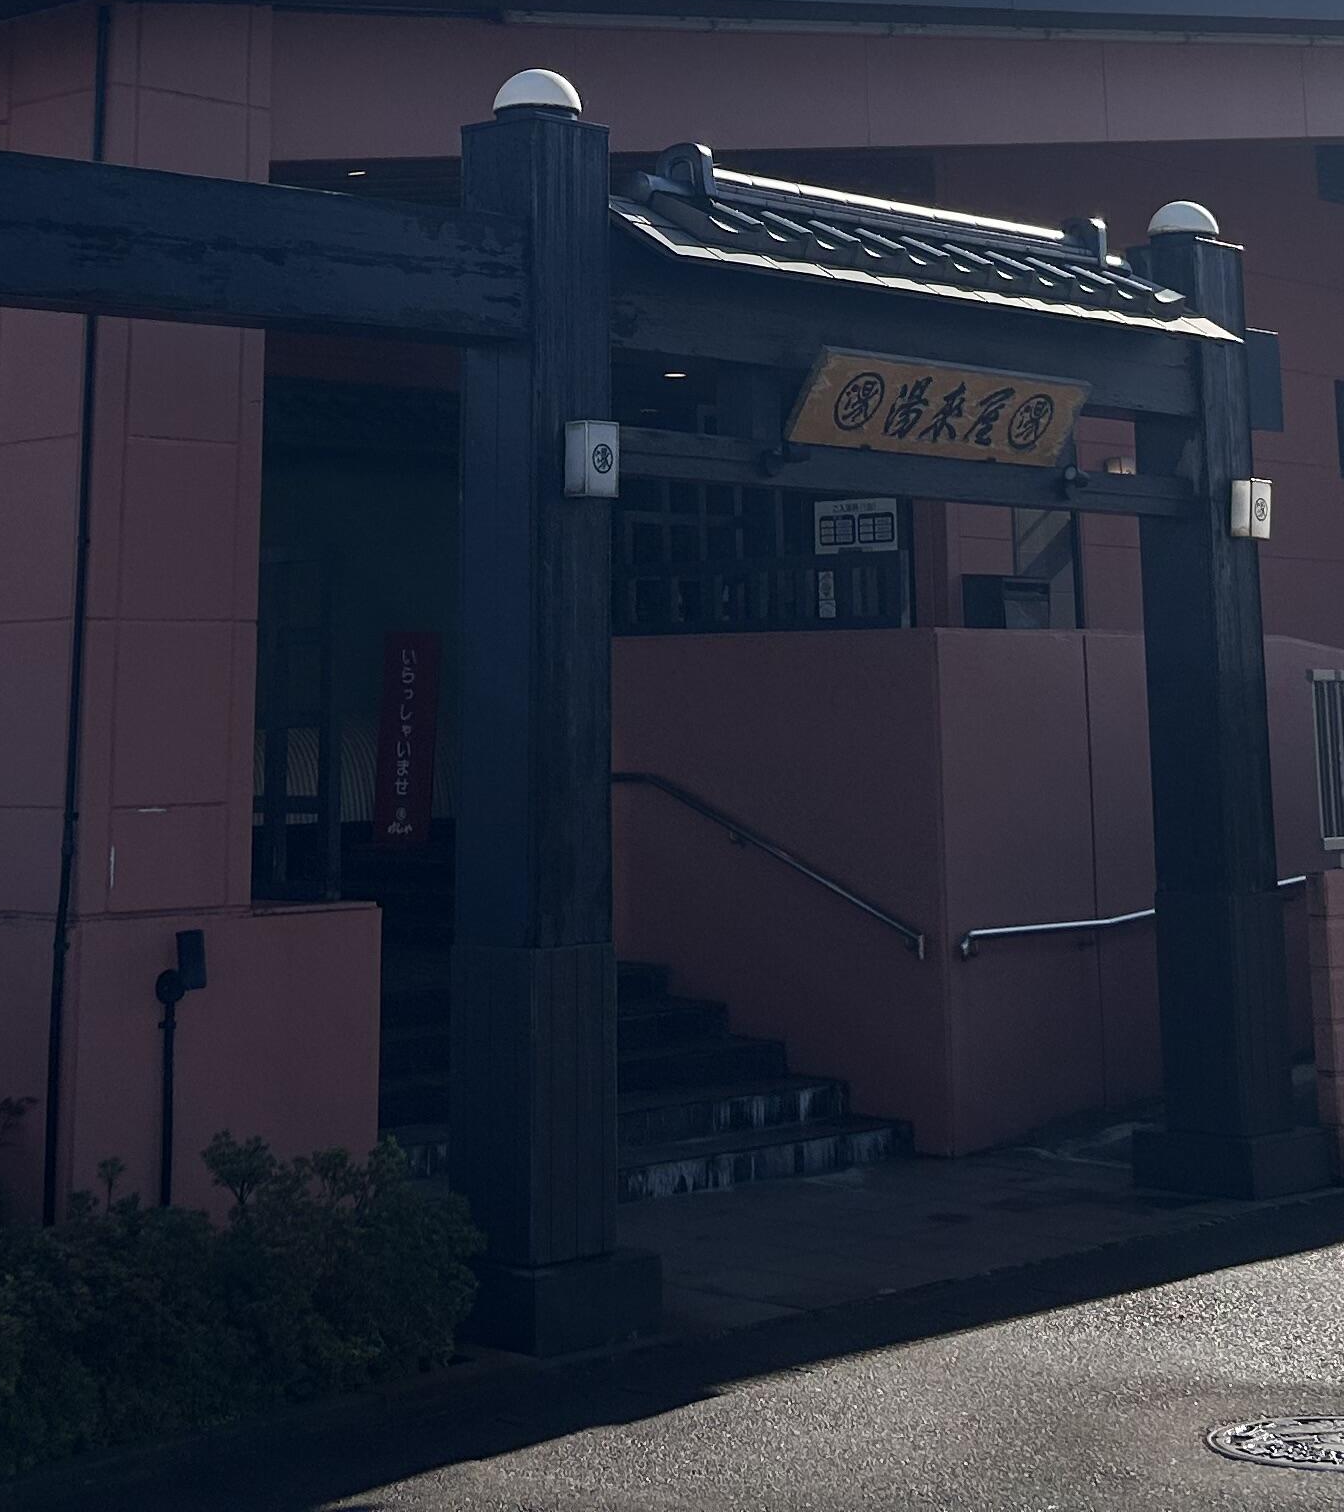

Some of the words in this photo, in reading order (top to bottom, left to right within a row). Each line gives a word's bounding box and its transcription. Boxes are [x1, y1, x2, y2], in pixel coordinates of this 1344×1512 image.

[395, 648, 416, 796] いらっしゃいませ
